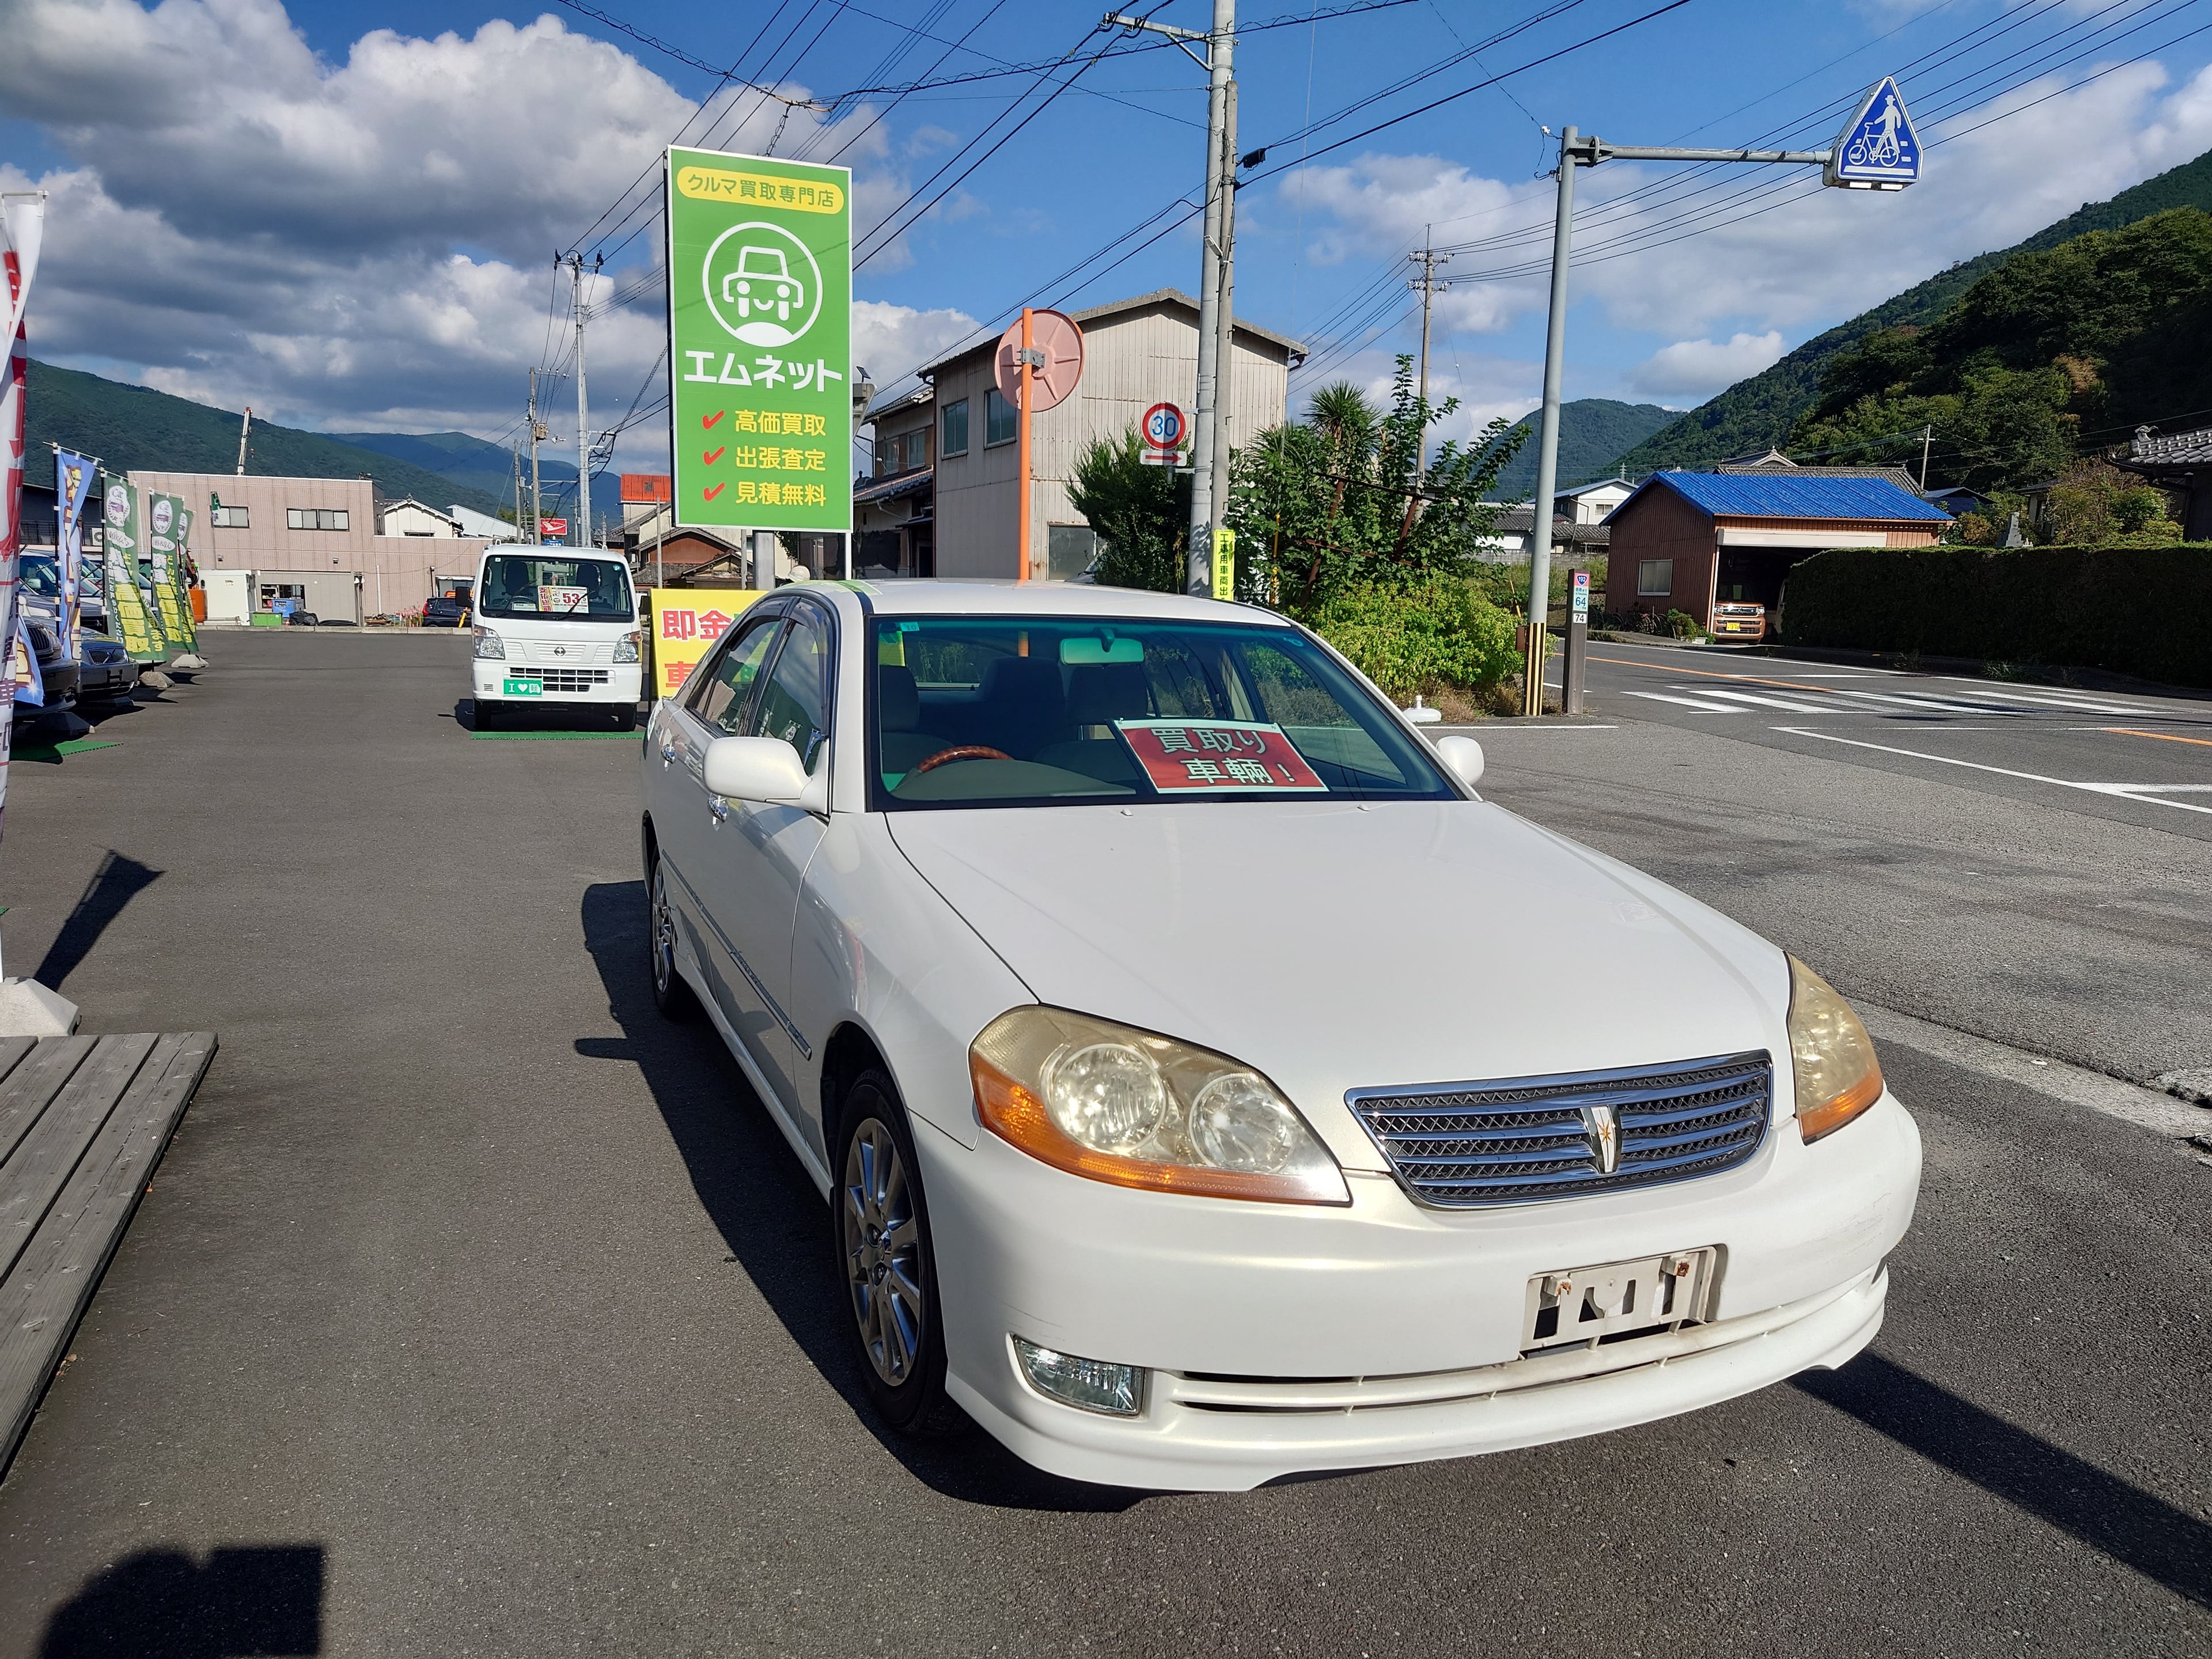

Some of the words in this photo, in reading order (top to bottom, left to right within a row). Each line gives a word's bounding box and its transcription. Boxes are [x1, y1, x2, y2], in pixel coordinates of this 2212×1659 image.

[688, 174, 834, 209] クルマ買取専門店
[684, 350, 842, 392] エムネット
[735, 410, 826, 437] 高価買取
[1152, 415, 1177, 437] 30
[736, 447, 826, 472] 出張査定
[736, 481, 826, 507] 見積無料
[1219, 533, 1229, 599] 工事用車両出
[1575, 596, 1586, 607] 64
[662, 609, 737, 641] 即金
[1575, 614, 1584, 622] 74
[1152, 728, 1266, 755] 買取り
